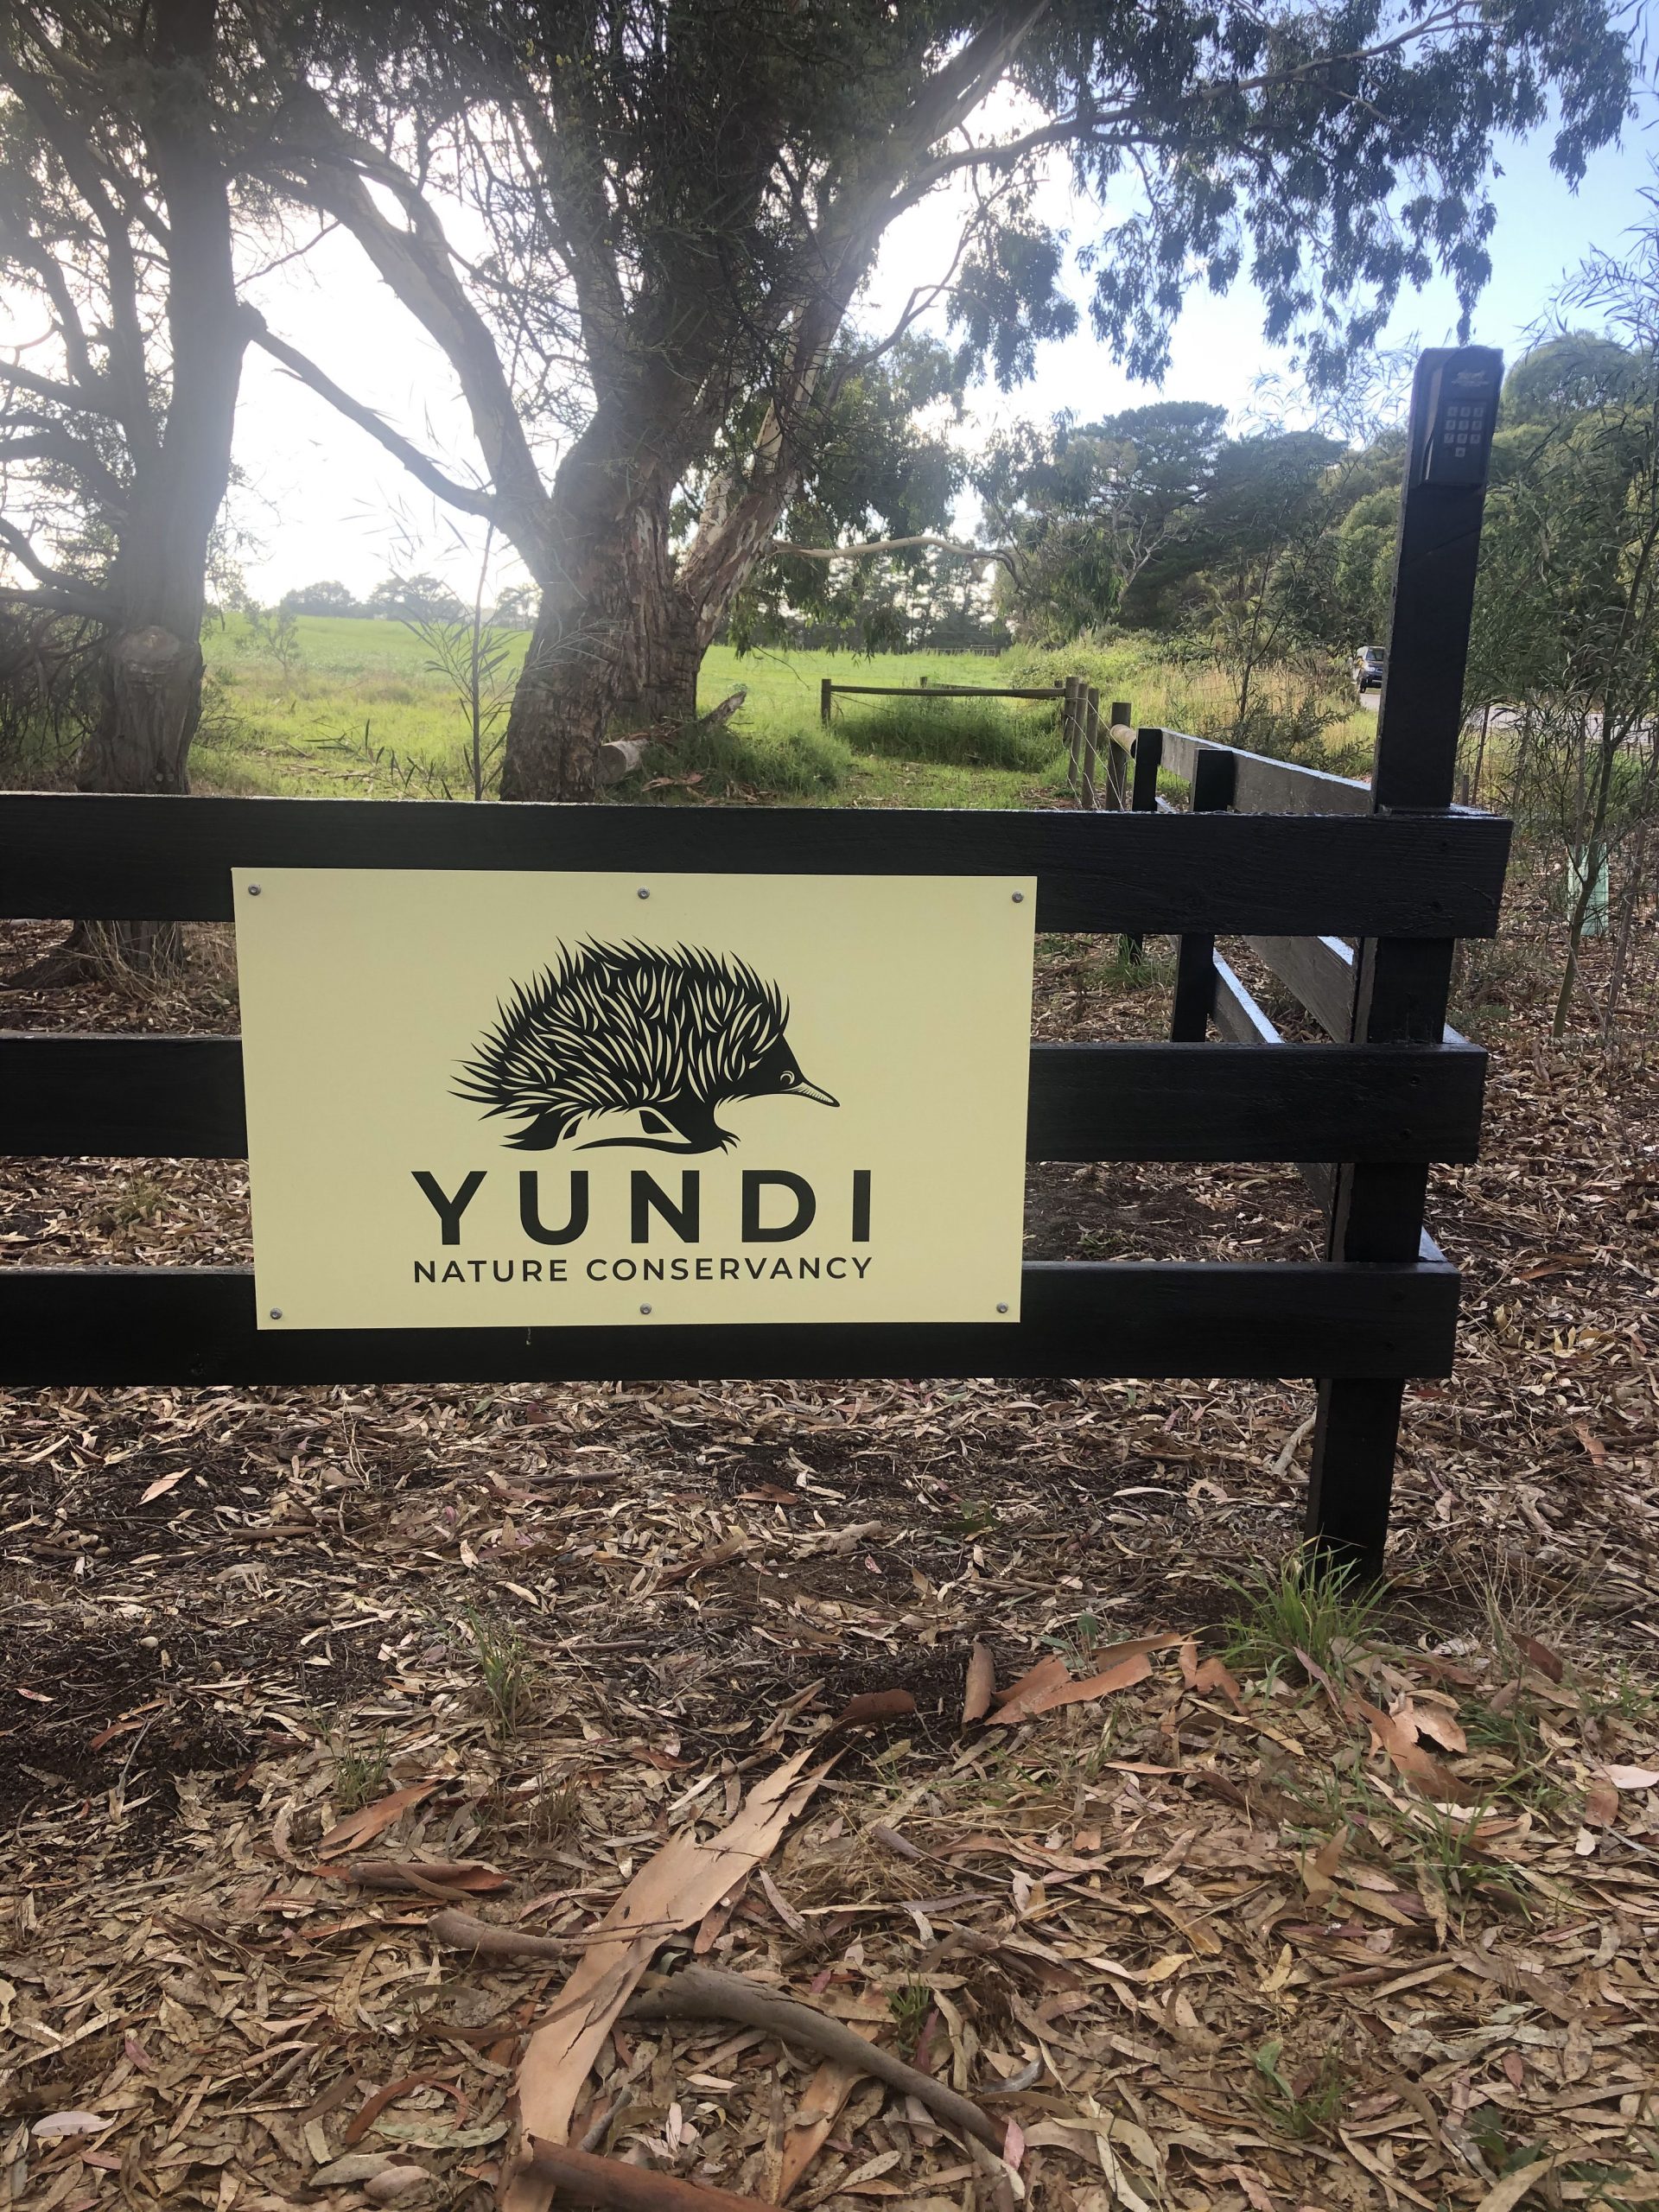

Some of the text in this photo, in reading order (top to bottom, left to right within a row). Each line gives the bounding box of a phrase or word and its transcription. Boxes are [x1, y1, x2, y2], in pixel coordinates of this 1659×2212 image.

[410, 1169, 872, 1246] YUNDI
[413, 1256, 873, 1283] NATURE CONSERVANCY
